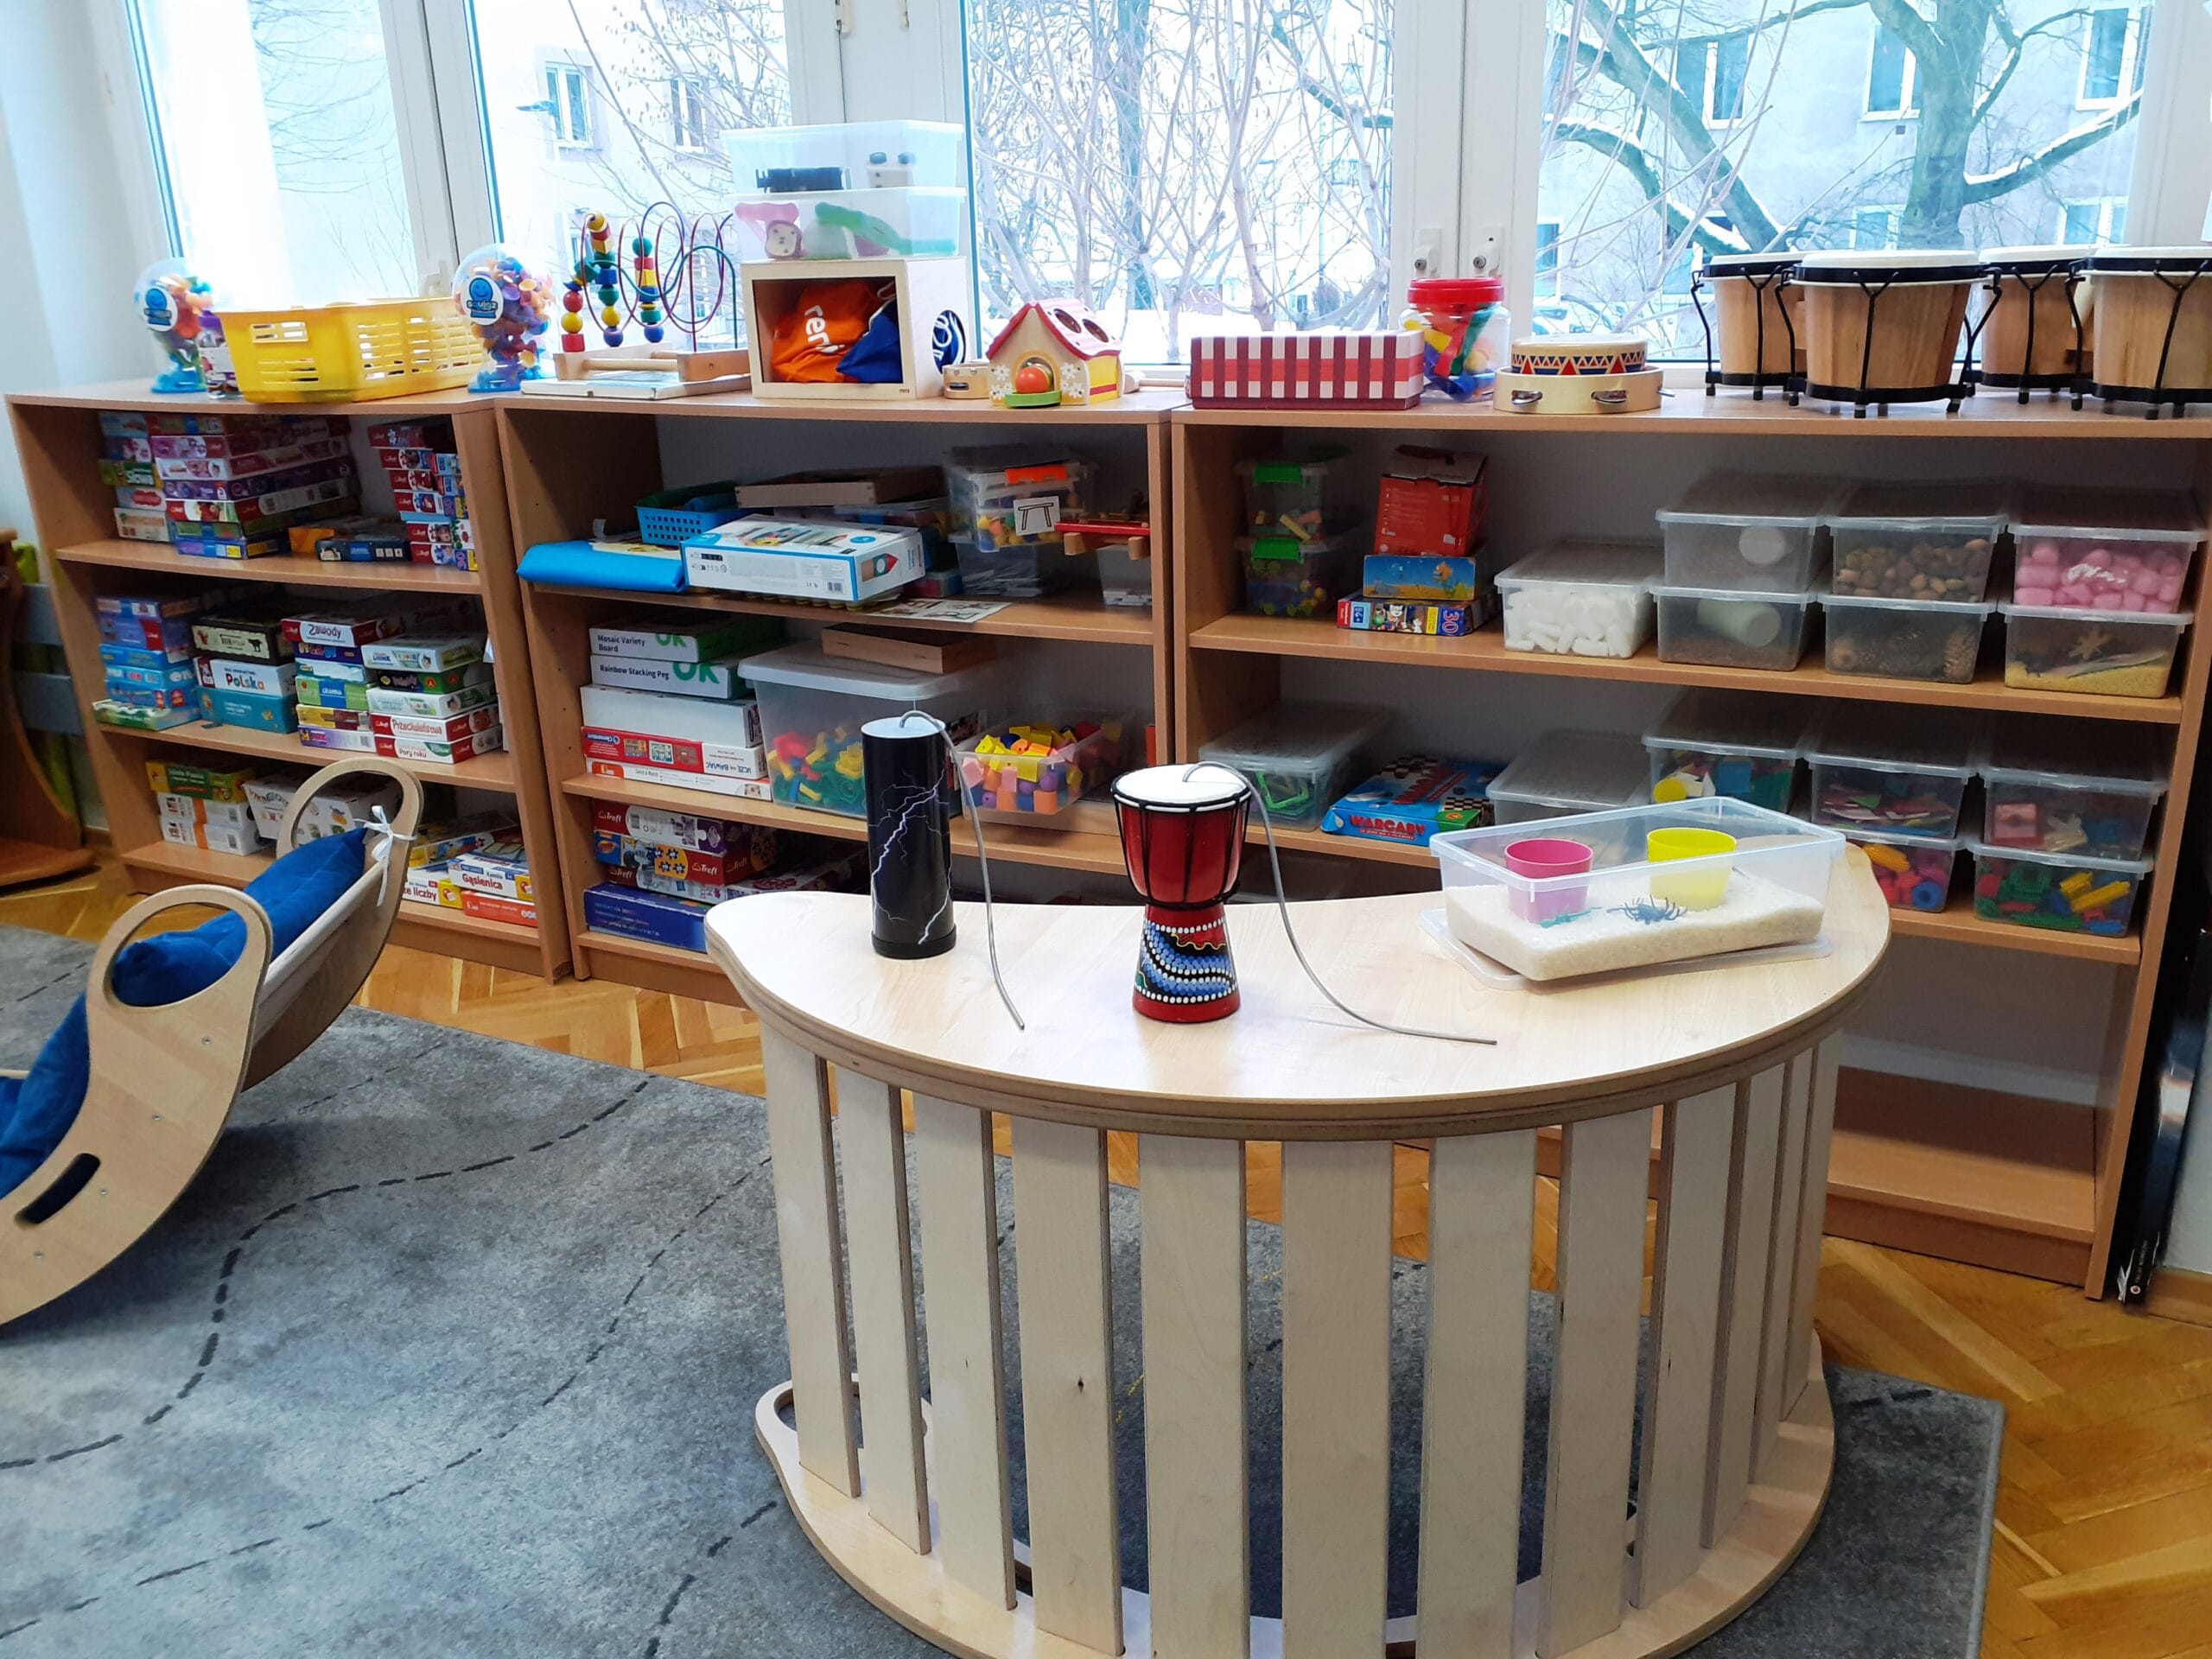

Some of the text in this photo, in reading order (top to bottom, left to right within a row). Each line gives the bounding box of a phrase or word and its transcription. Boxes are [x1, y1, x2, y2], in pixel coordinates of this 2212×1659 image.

[1441, 610, 1459, 633] 30
[308, 624, 341, 639] Zawody
[598, 635, 645, 647] Mosaic Variety
[599, 644, 619, 652] Board
[600, 664, 670, 681] Rainbow Stacking Peg
[226, 673, 265, 690] Polska
[1350, 815, 1427, 835] WARCABY
[701, 864, 718, 875] Trefl
[462, 873, 504, 890] Gąsienica
[413, 887, 437, 901] liczby
